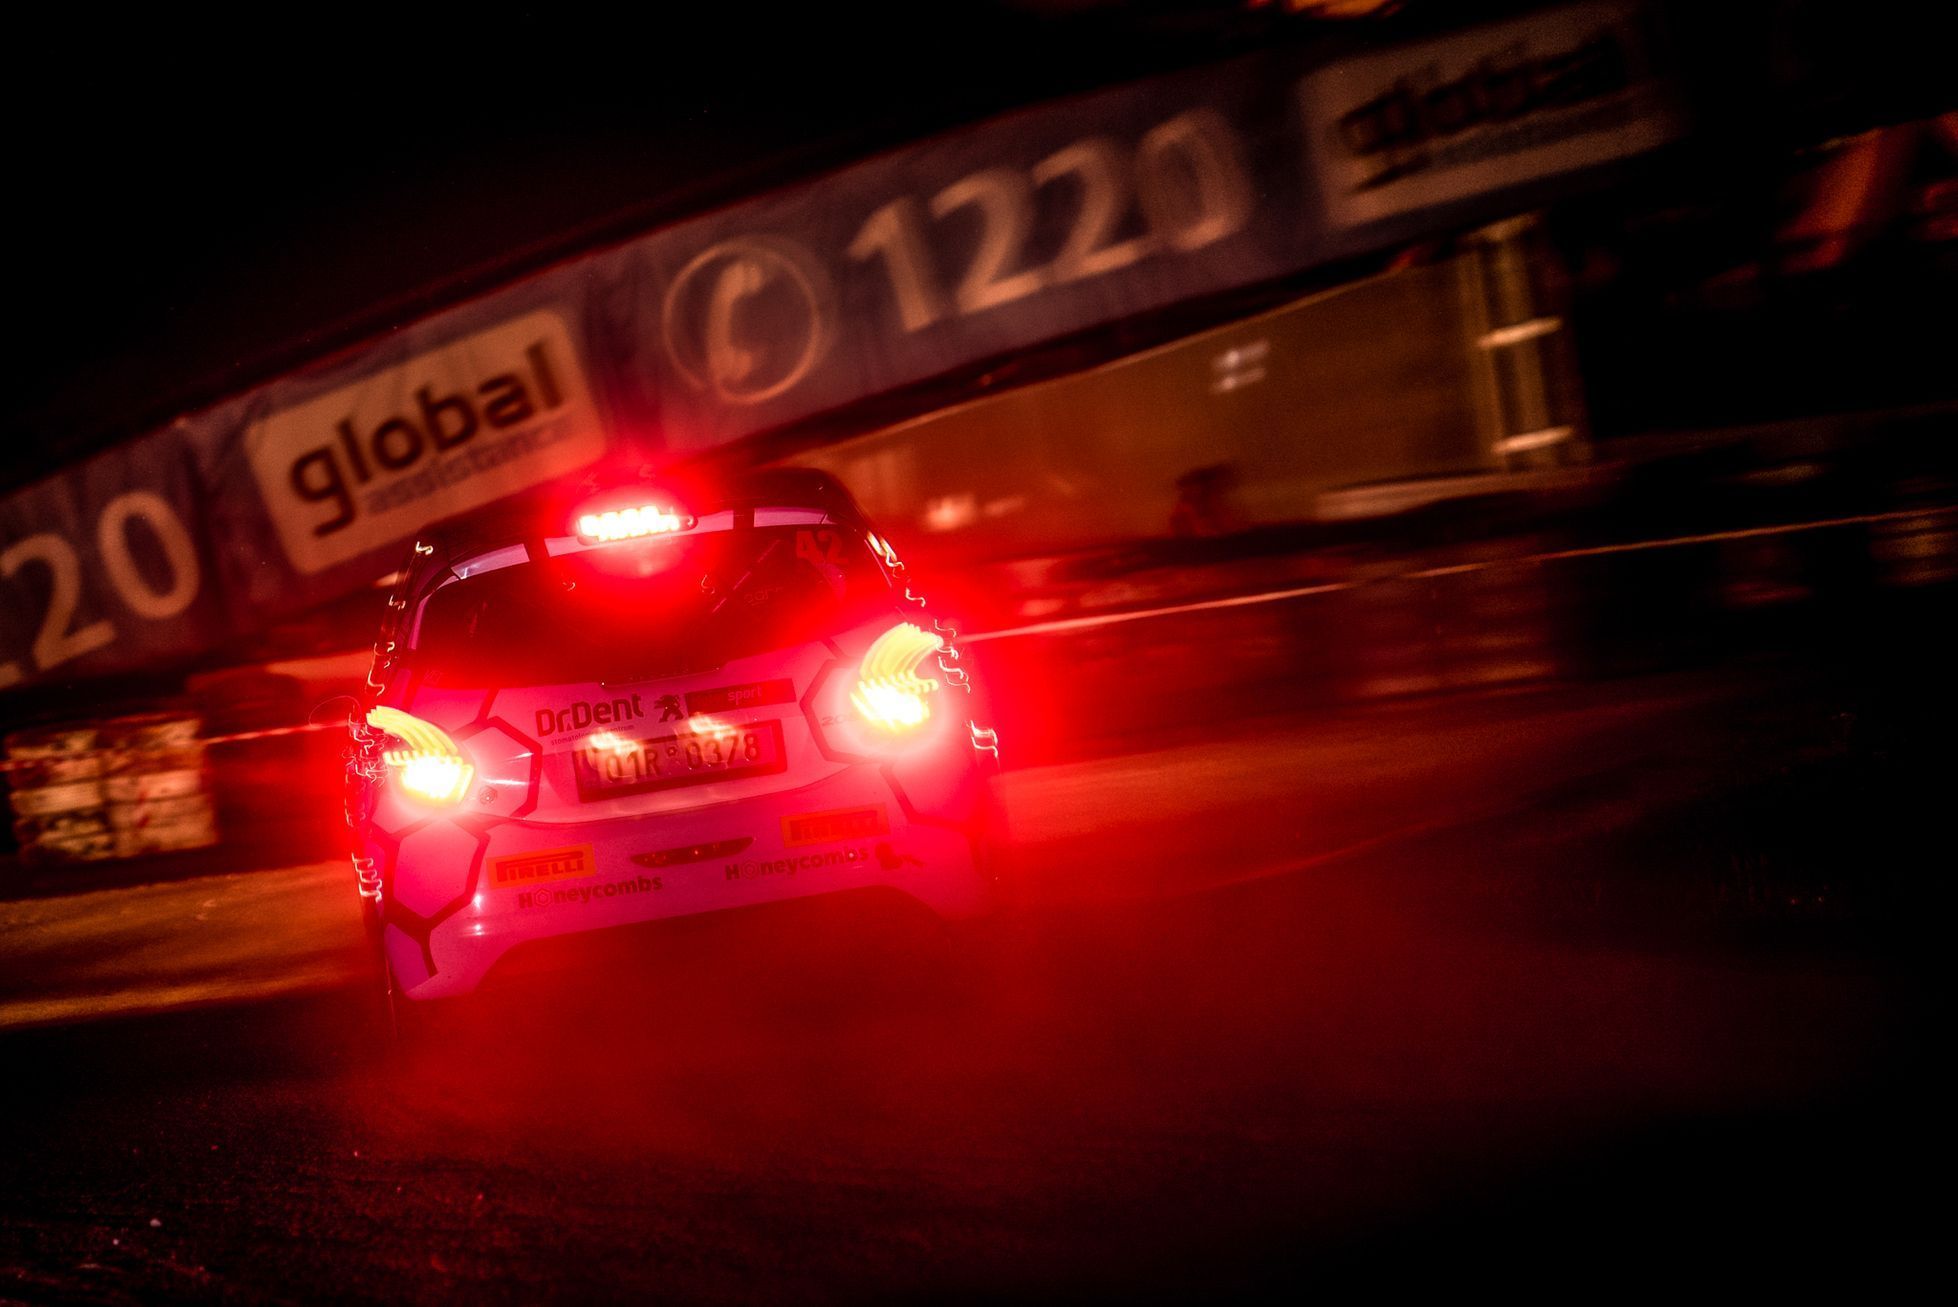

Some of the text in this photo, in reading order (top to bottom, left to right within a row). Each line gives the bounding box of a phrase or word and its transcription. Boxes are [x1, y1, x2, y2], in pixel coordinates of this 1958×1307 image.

[848, 106, 1254, 332] 1220
[289, 343, 563, 537] global
[0, 490, 200, 690] 20
[728, 684, 763, 706] sport
[496, 851, 584, 882] PIRELLI
[517, 875, 663, 909] Honeycombs
